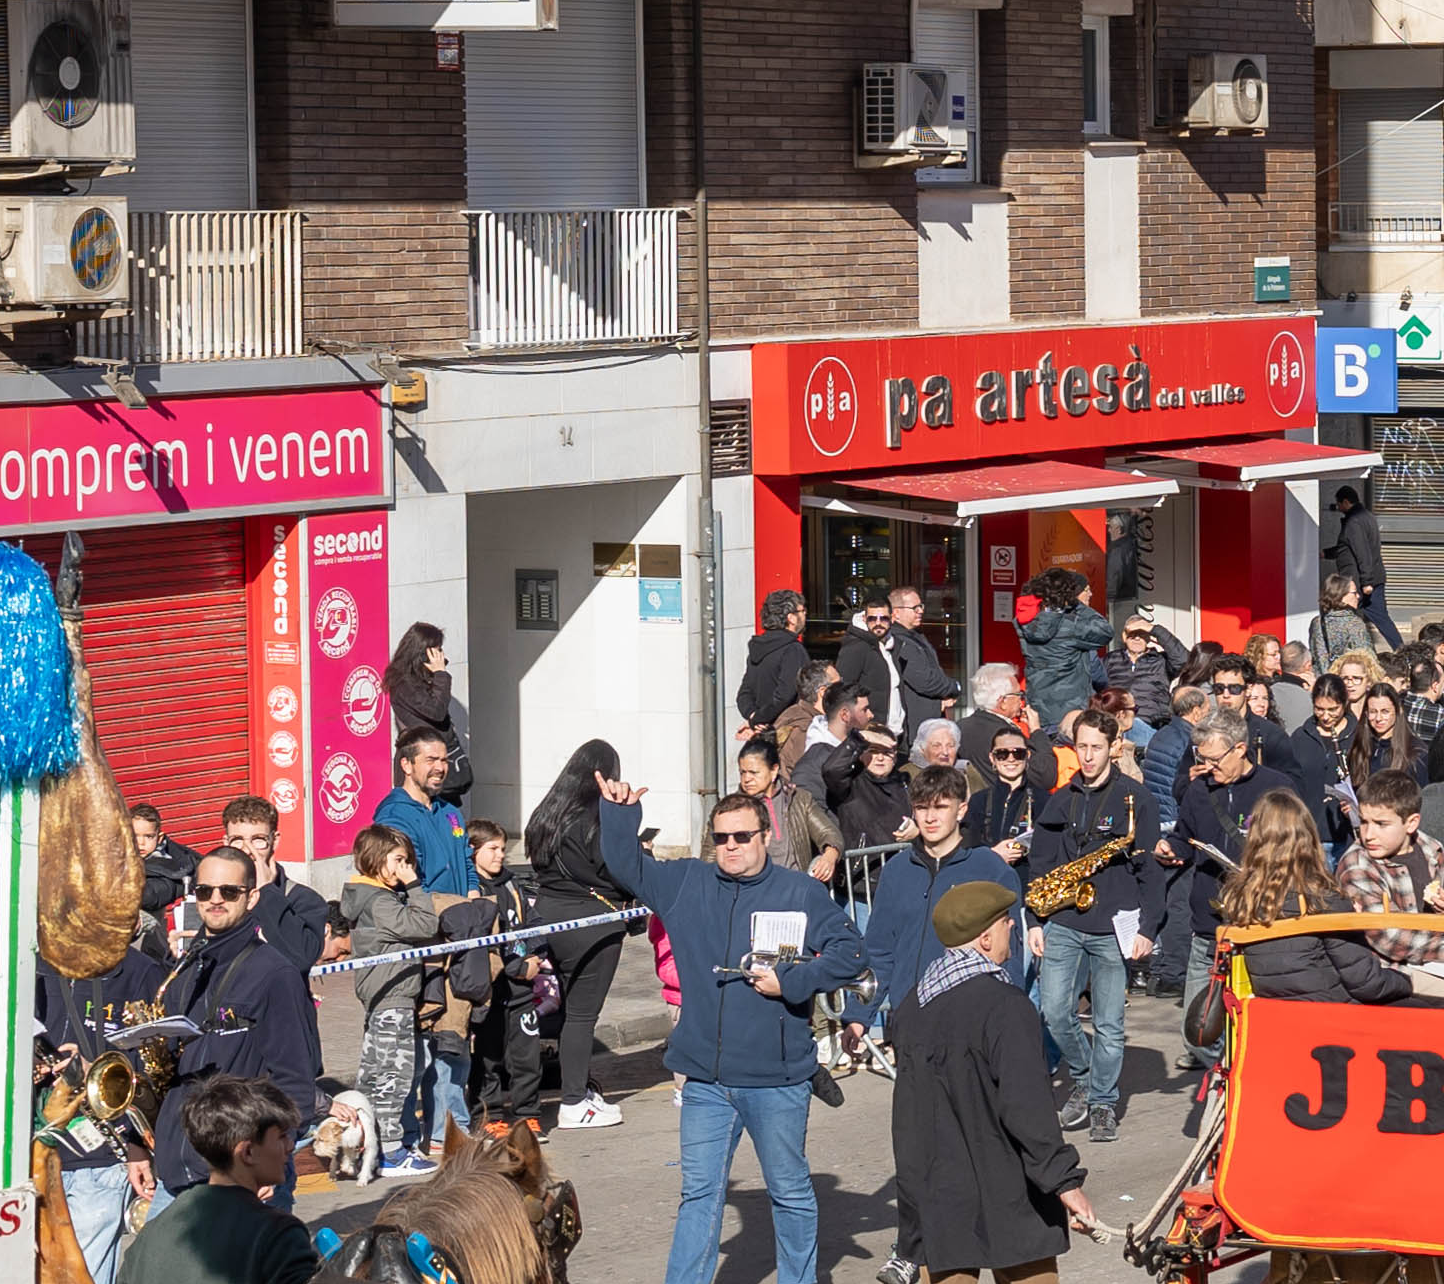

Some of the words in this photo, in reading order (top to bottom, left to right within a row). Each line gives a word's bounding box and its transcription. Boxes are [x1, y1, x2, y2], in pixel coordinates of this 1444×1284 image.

[886, 375, 954, 449] pa
[975, 344, 1151, 425] artesà
[1157, 386, 1186, 410] del
[1191, 381, 1246, 406] vallès
[206, 421, 214, 486] i
[227, 427, 370, 483] venem
[273, 525, 288, 634] second
[313, 524, 383, 556] second
